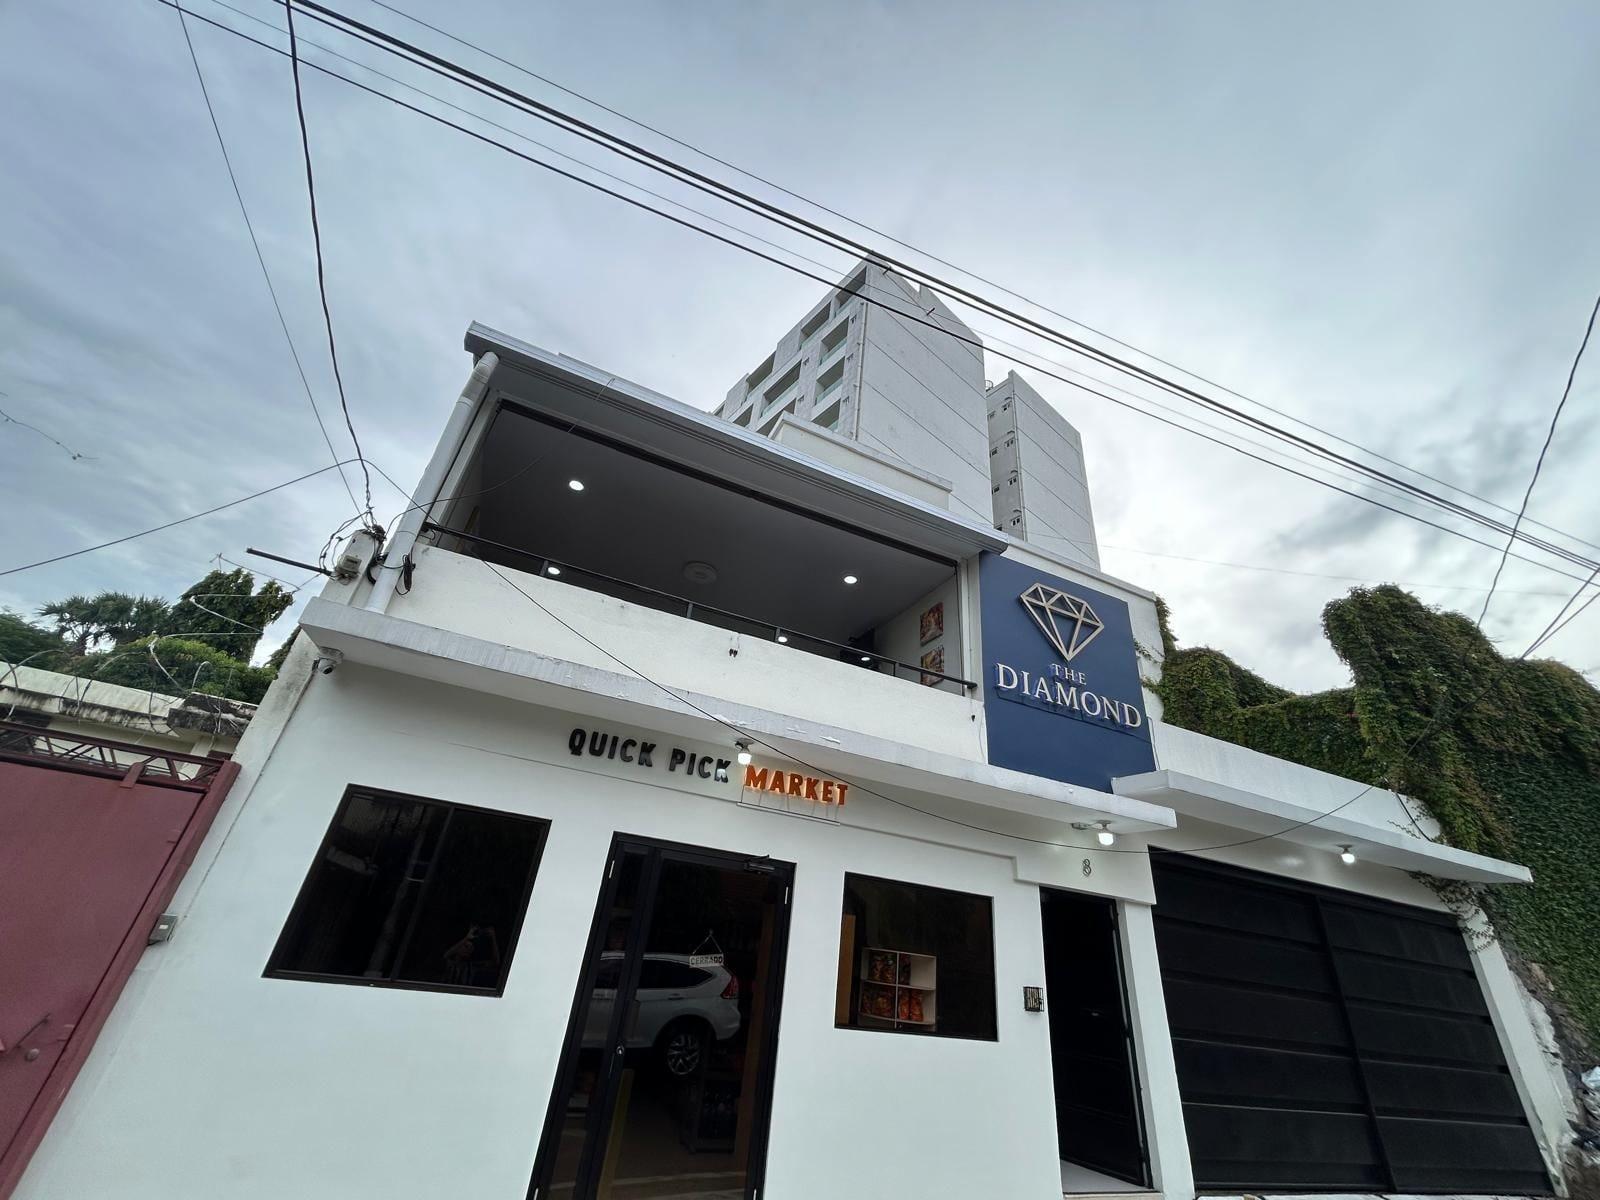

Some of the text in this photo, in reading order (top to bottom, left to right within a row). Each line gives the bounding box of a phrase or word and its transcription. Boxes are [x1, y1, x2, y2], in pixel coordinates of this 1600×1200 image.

[1051, 663, 1087, 686] THE
[995, 662, 1142, 728] DIAMOND
[568, 728, 848, 806] QUICK PICK MARKET
[1082, 858, 1092, 877] 8
[690, 956, 723, 965] CERRADO
